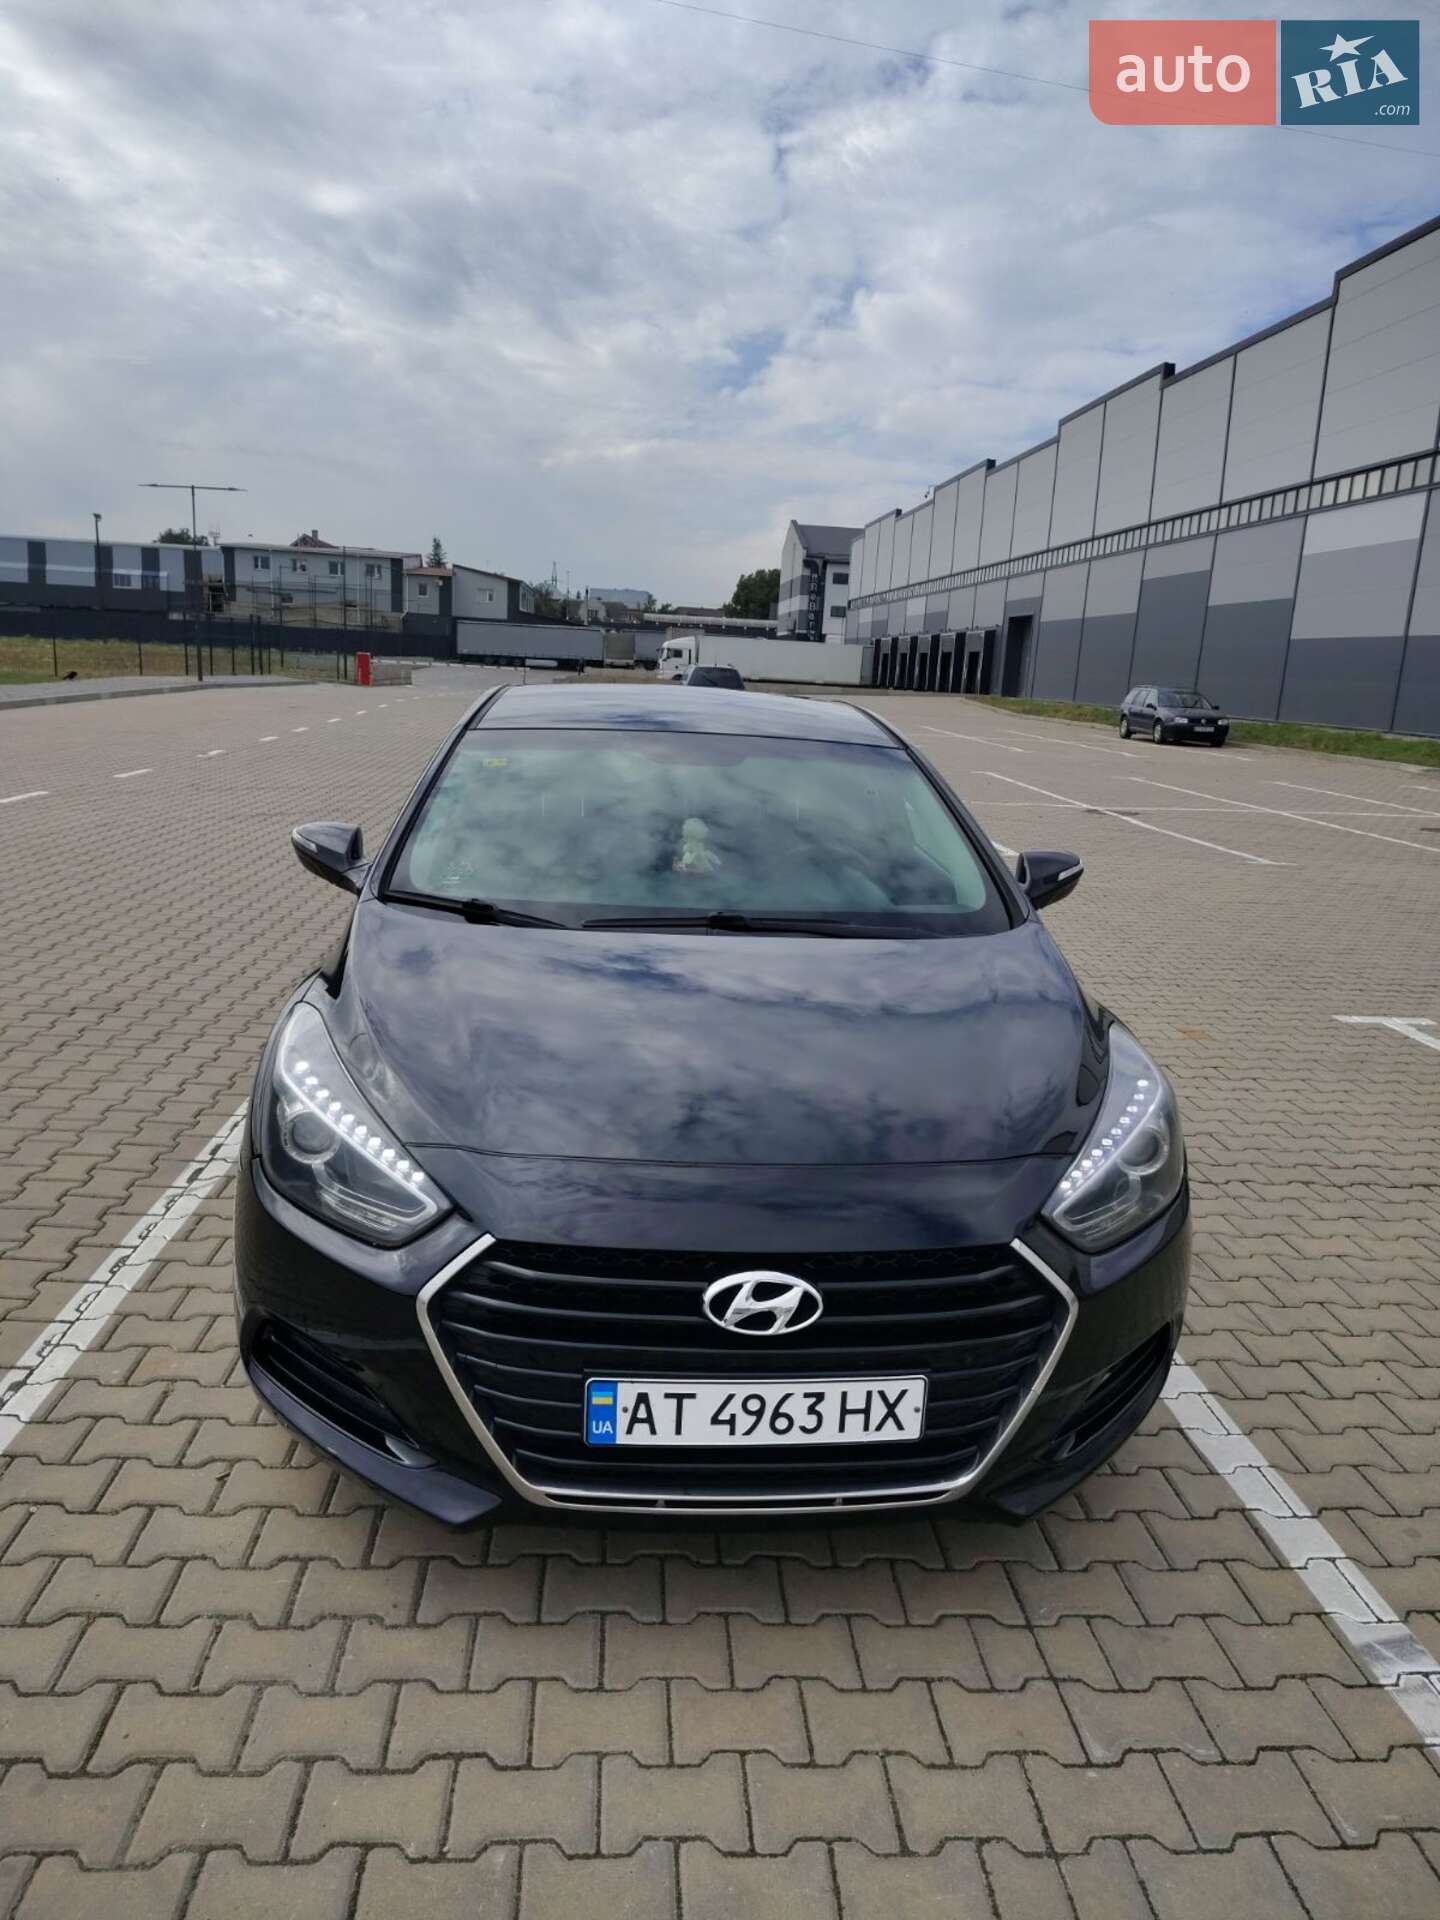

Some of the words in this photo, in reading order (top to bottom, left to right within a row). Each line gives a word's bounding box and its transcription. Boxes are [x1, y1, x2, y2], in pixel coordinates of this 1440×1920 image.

[592, 1420, 614, 1434] UA
[625, 1391, 697, 1436] AT
[710, 1391, 825, 1436] 4963
[838, 1389, 909, 1433] HX
